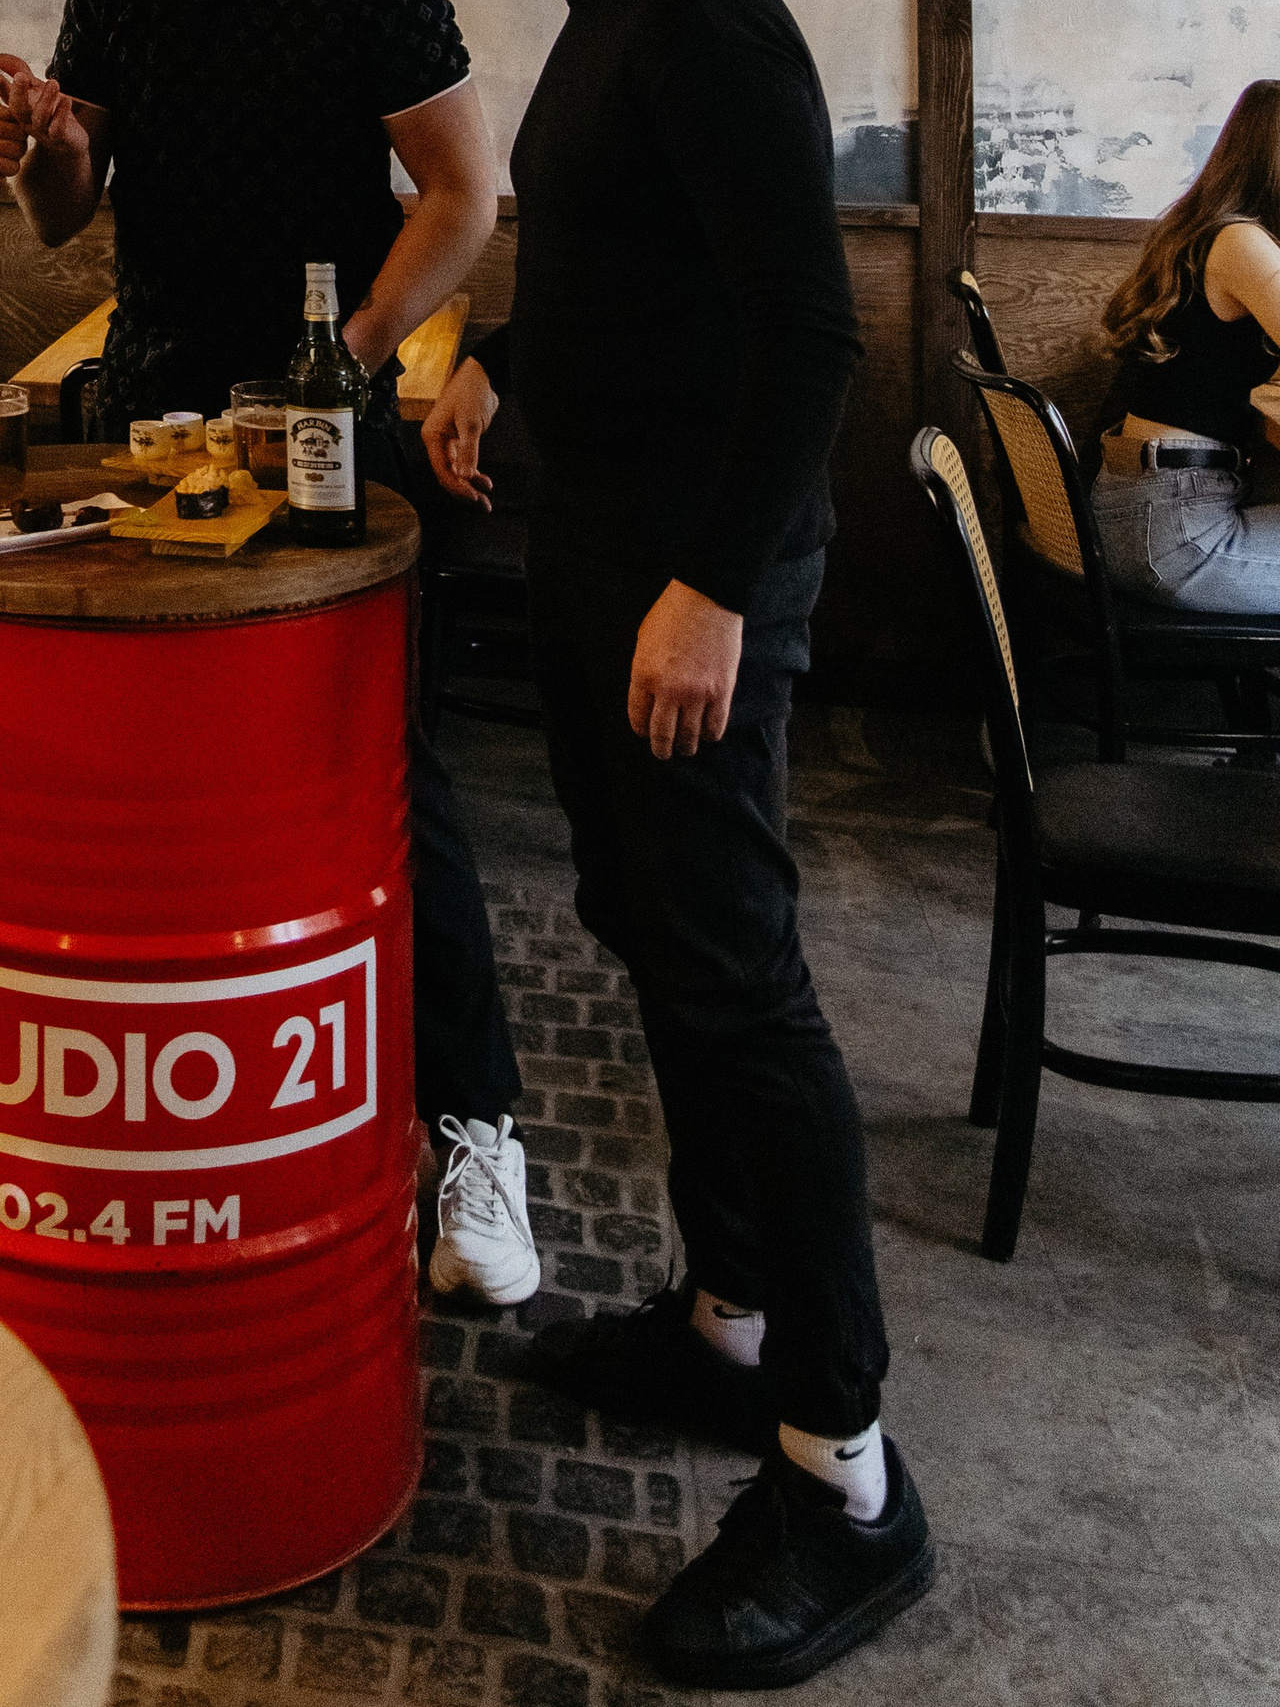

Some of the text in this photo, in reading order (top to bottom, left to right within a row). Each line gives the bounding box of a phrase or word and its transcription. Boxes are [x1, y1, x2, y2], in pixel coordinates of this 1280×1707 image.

[296, 419, 332, 432] HARBIN
[270, 1000, 346, 1110] 21
[153, 1194, 241, 1246] FM
